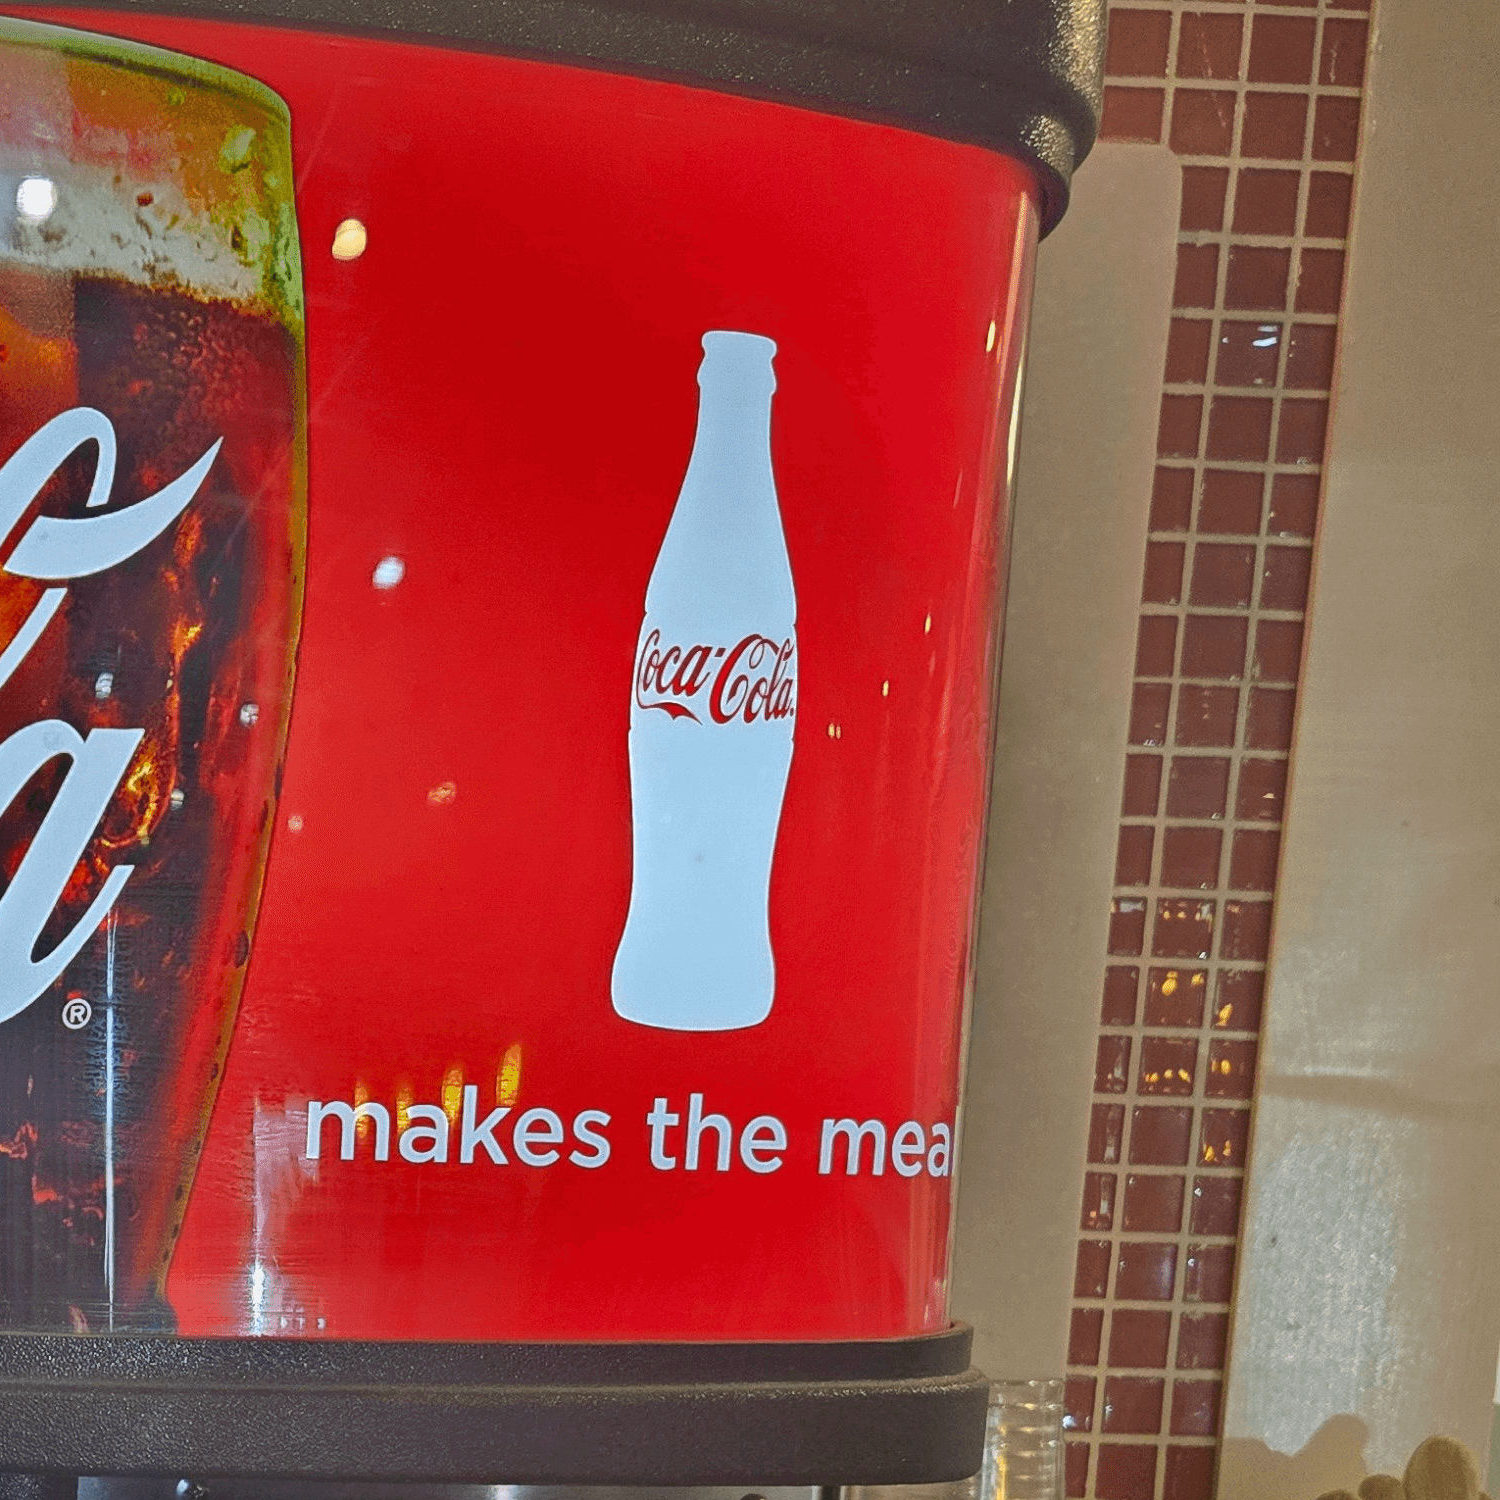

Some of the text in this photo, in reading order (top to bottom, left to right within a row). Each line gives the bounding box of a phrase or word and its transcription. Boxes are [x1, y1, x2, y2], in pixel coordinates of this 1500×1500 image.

[636, 628, 795, 726] Coca-Cola
[305, 1085, 612, 1169] makes
[647, 1093, 788, 1174] the
